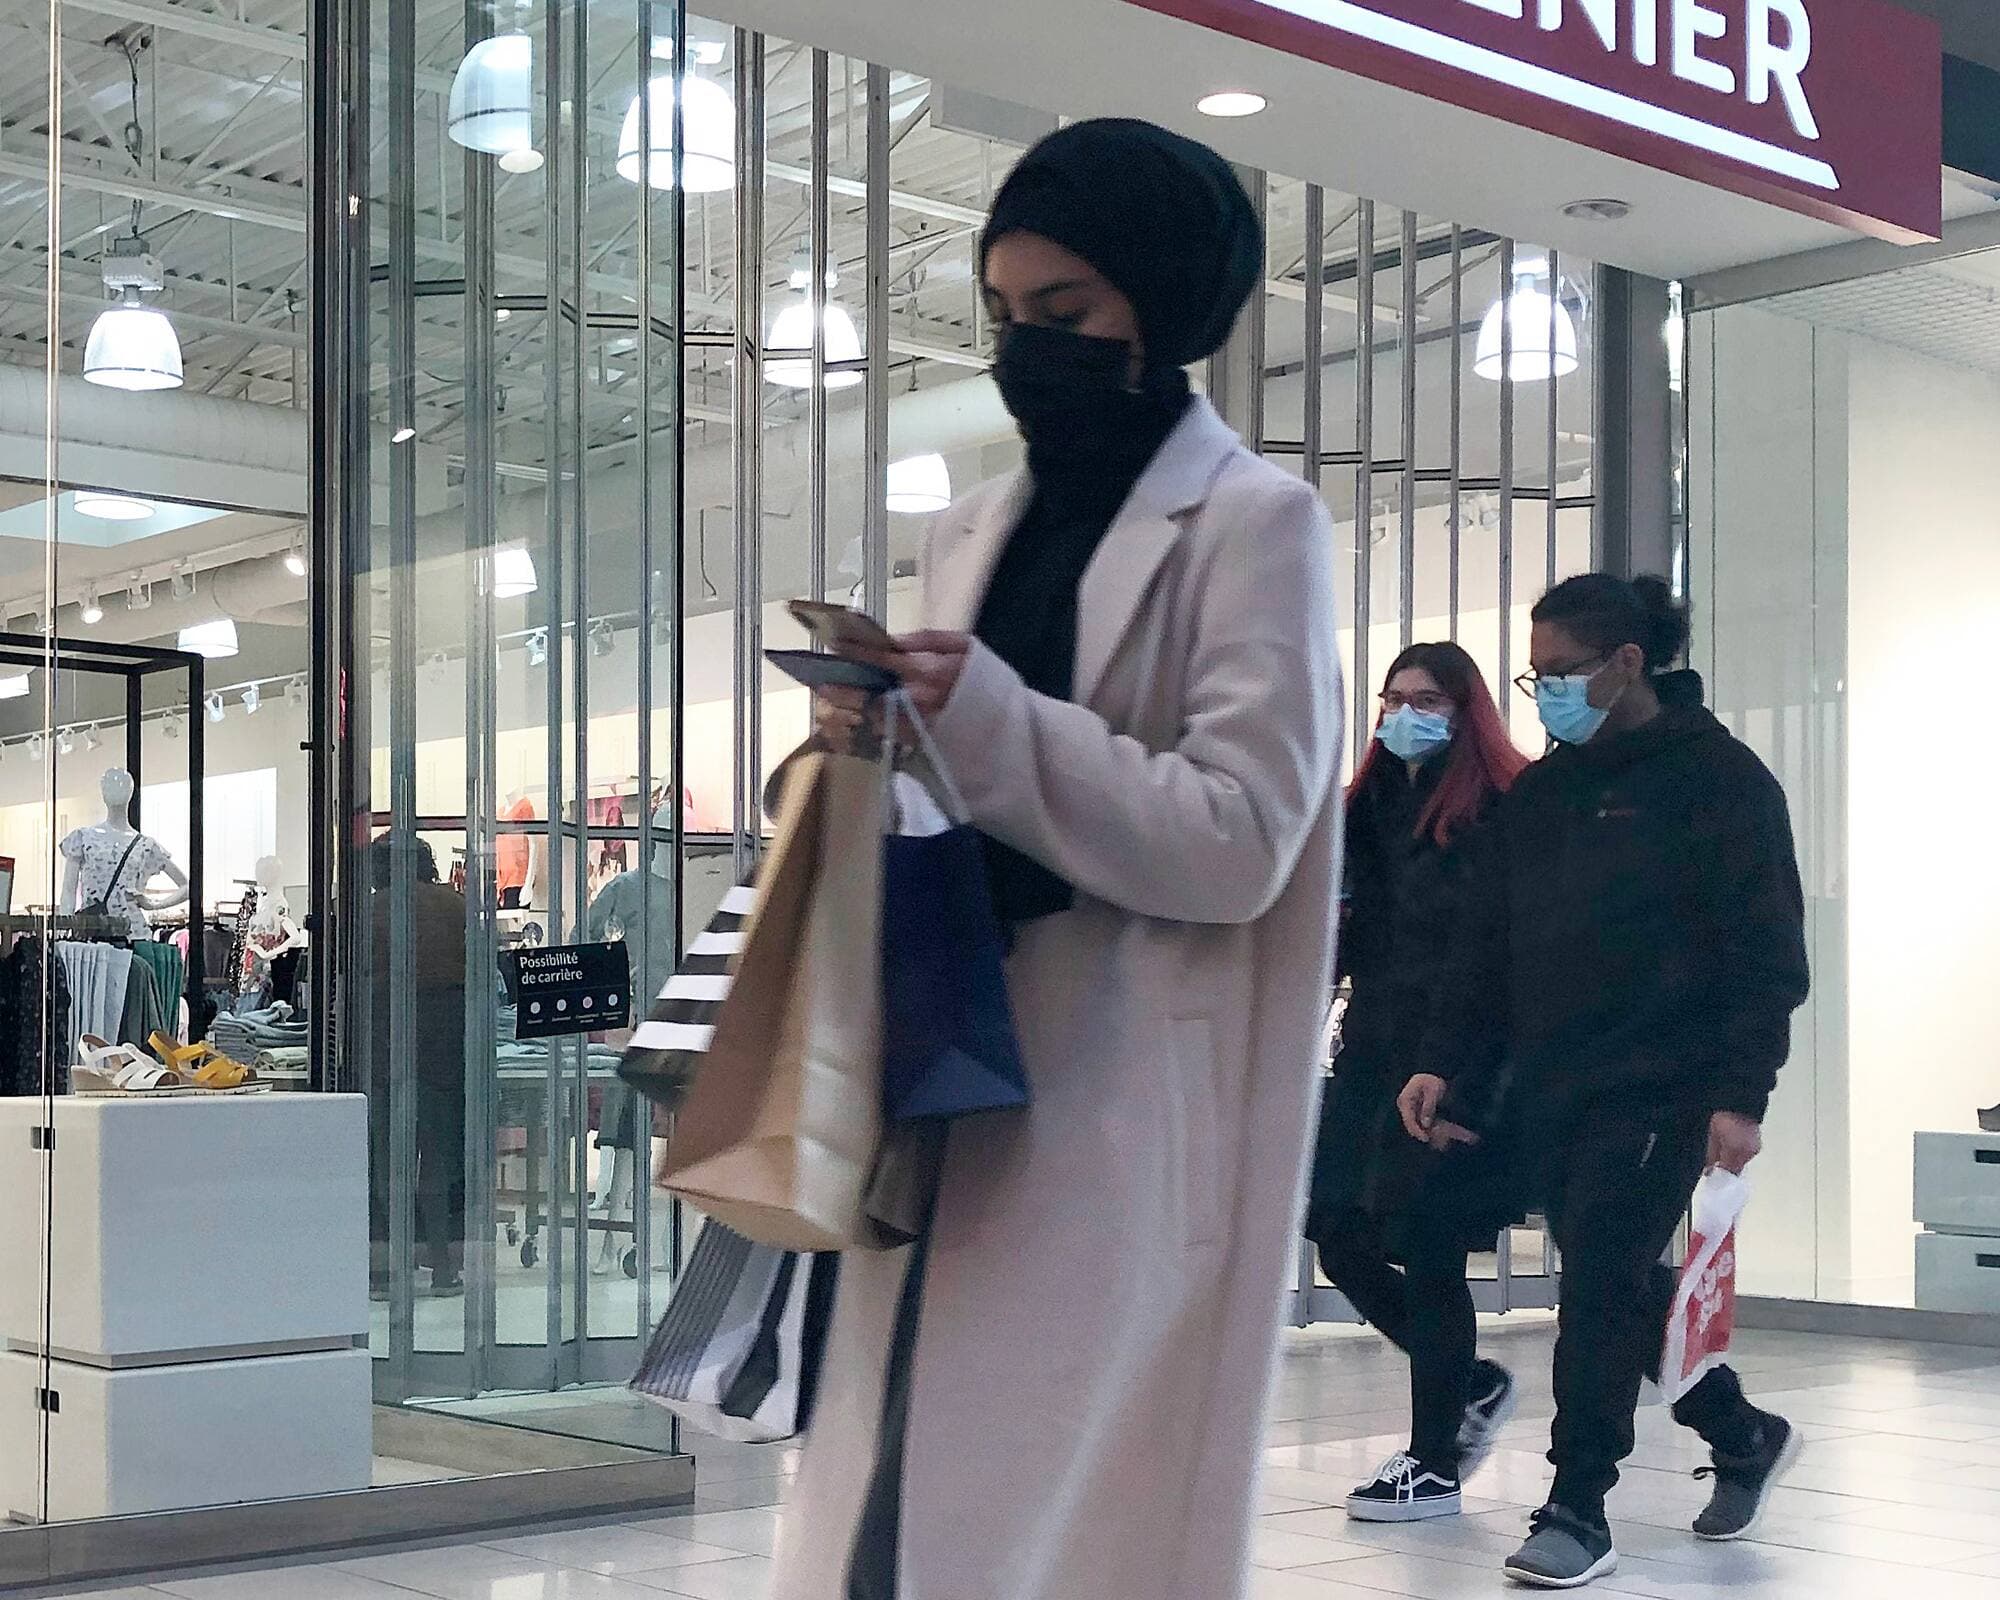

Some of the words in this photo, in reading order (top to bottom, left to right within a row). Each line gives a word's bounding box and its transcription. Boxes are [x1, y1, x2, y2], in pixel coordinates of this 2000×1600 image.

[1460, 0, 1820, 140] IER
[519, 951, 579, 969] Possibilité
[521, 971, 536, 985] de
[537, 967, 583, 984] carrière
